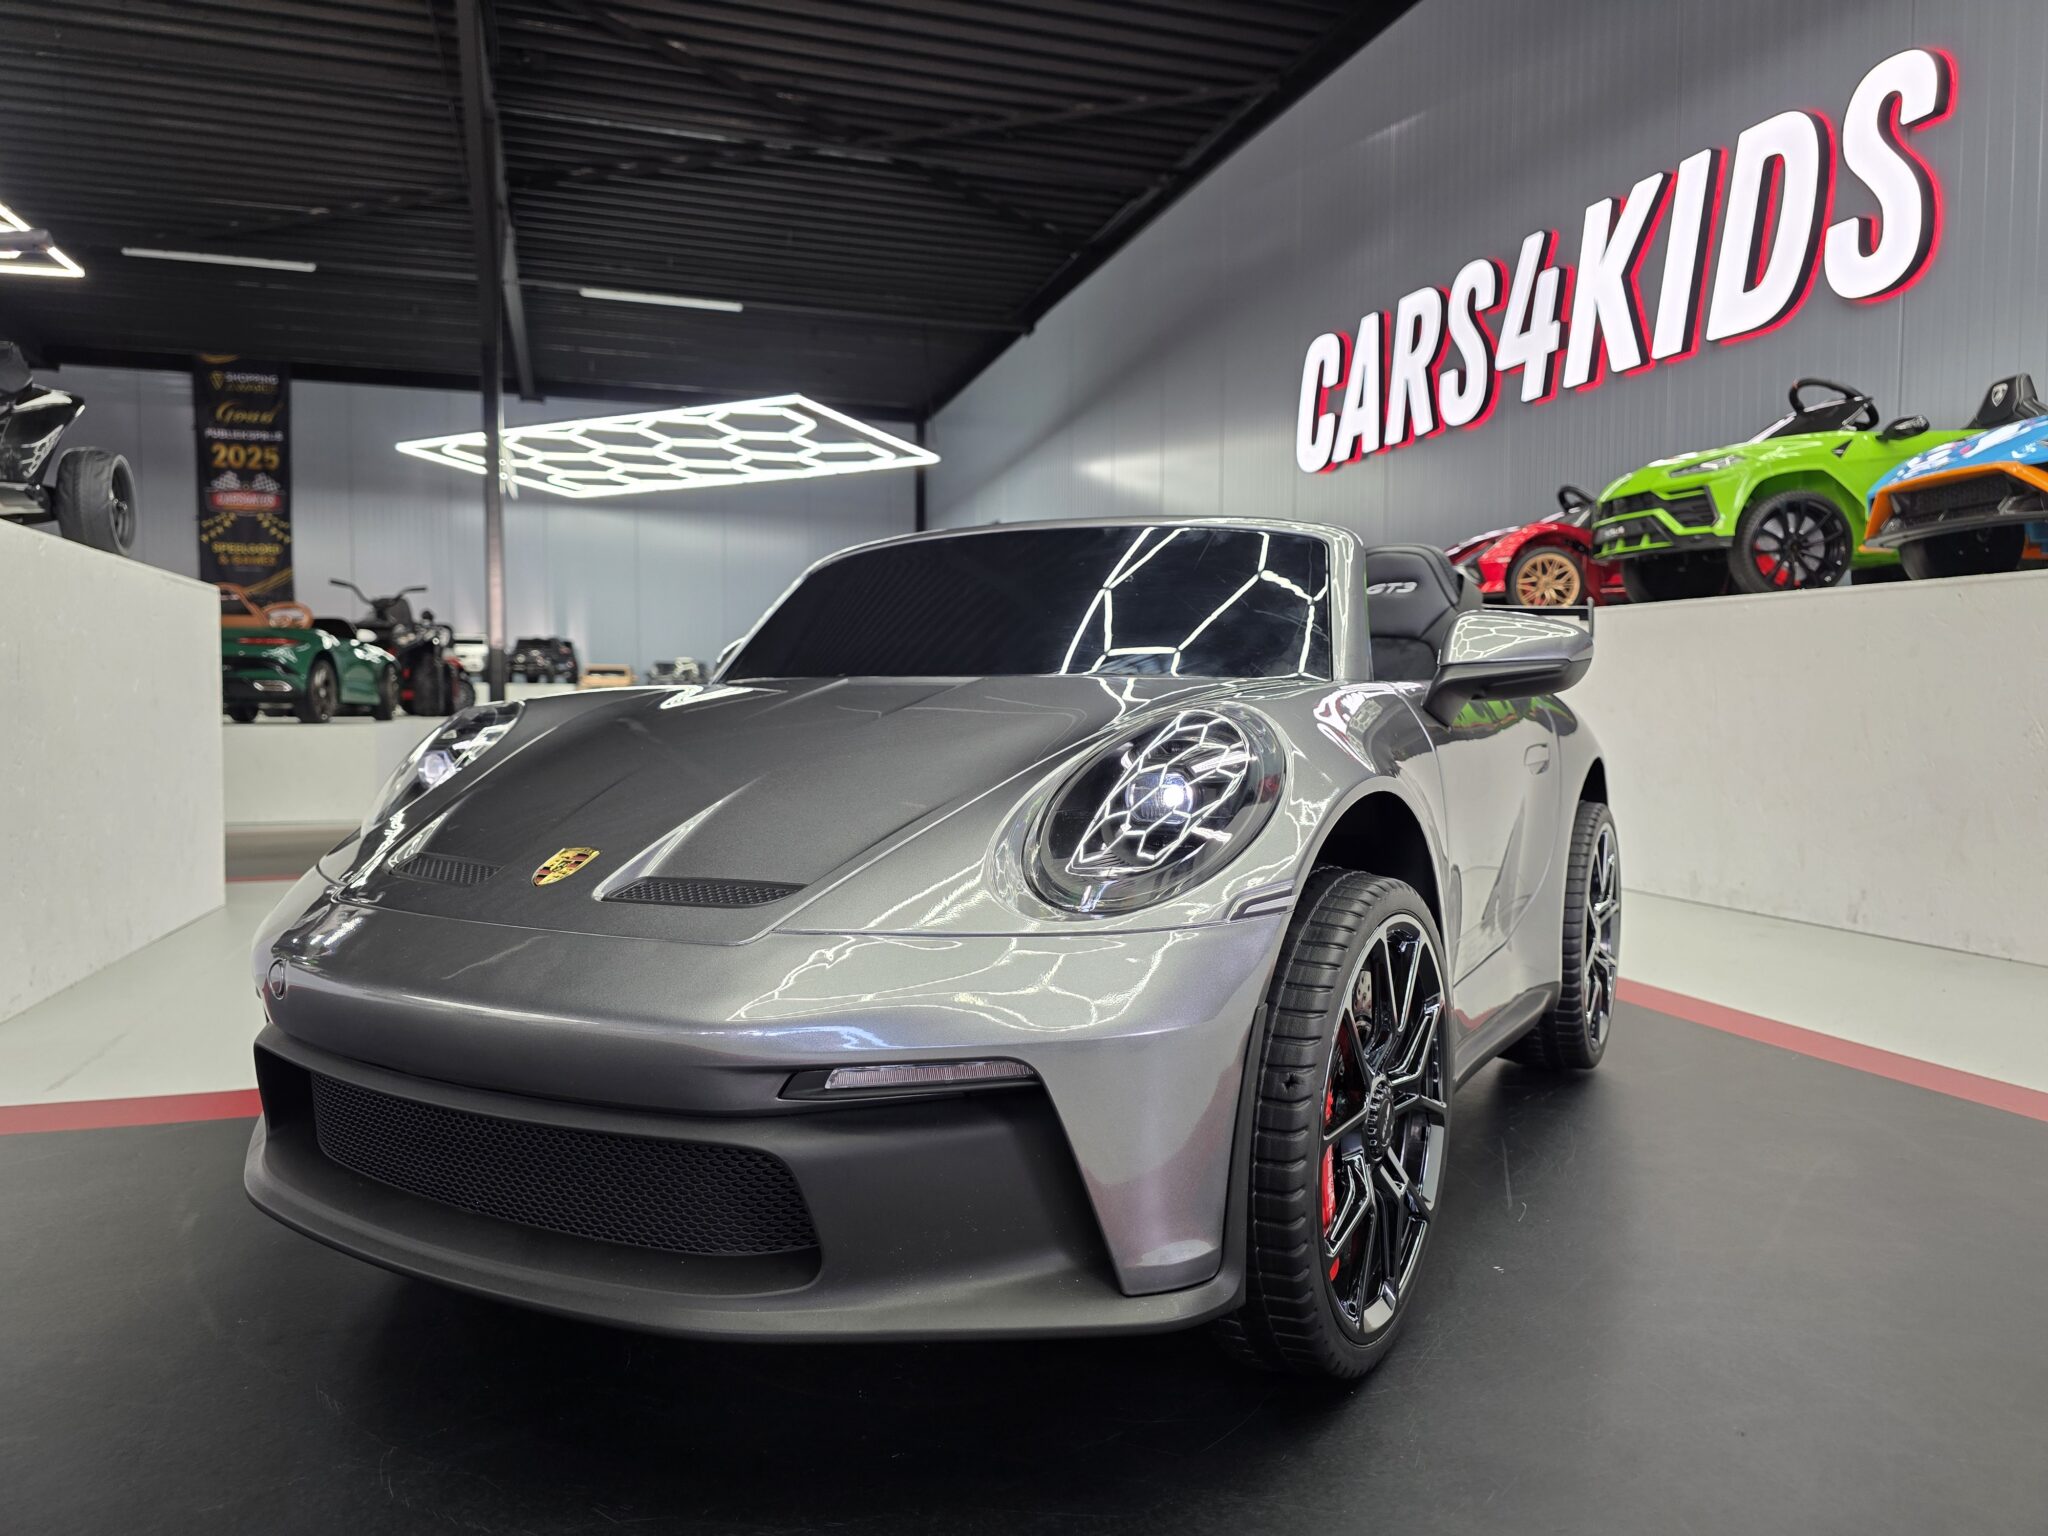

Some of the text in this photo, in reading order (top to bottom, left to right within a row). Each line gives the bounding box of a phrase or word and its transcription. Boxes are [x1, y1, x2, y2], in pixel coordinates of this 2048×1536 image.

[1296, 47, 1955, 474] CARS4KIDS
[211, 442, 280, 470] 2025
[1366, 581, 1417, 595] GT3
